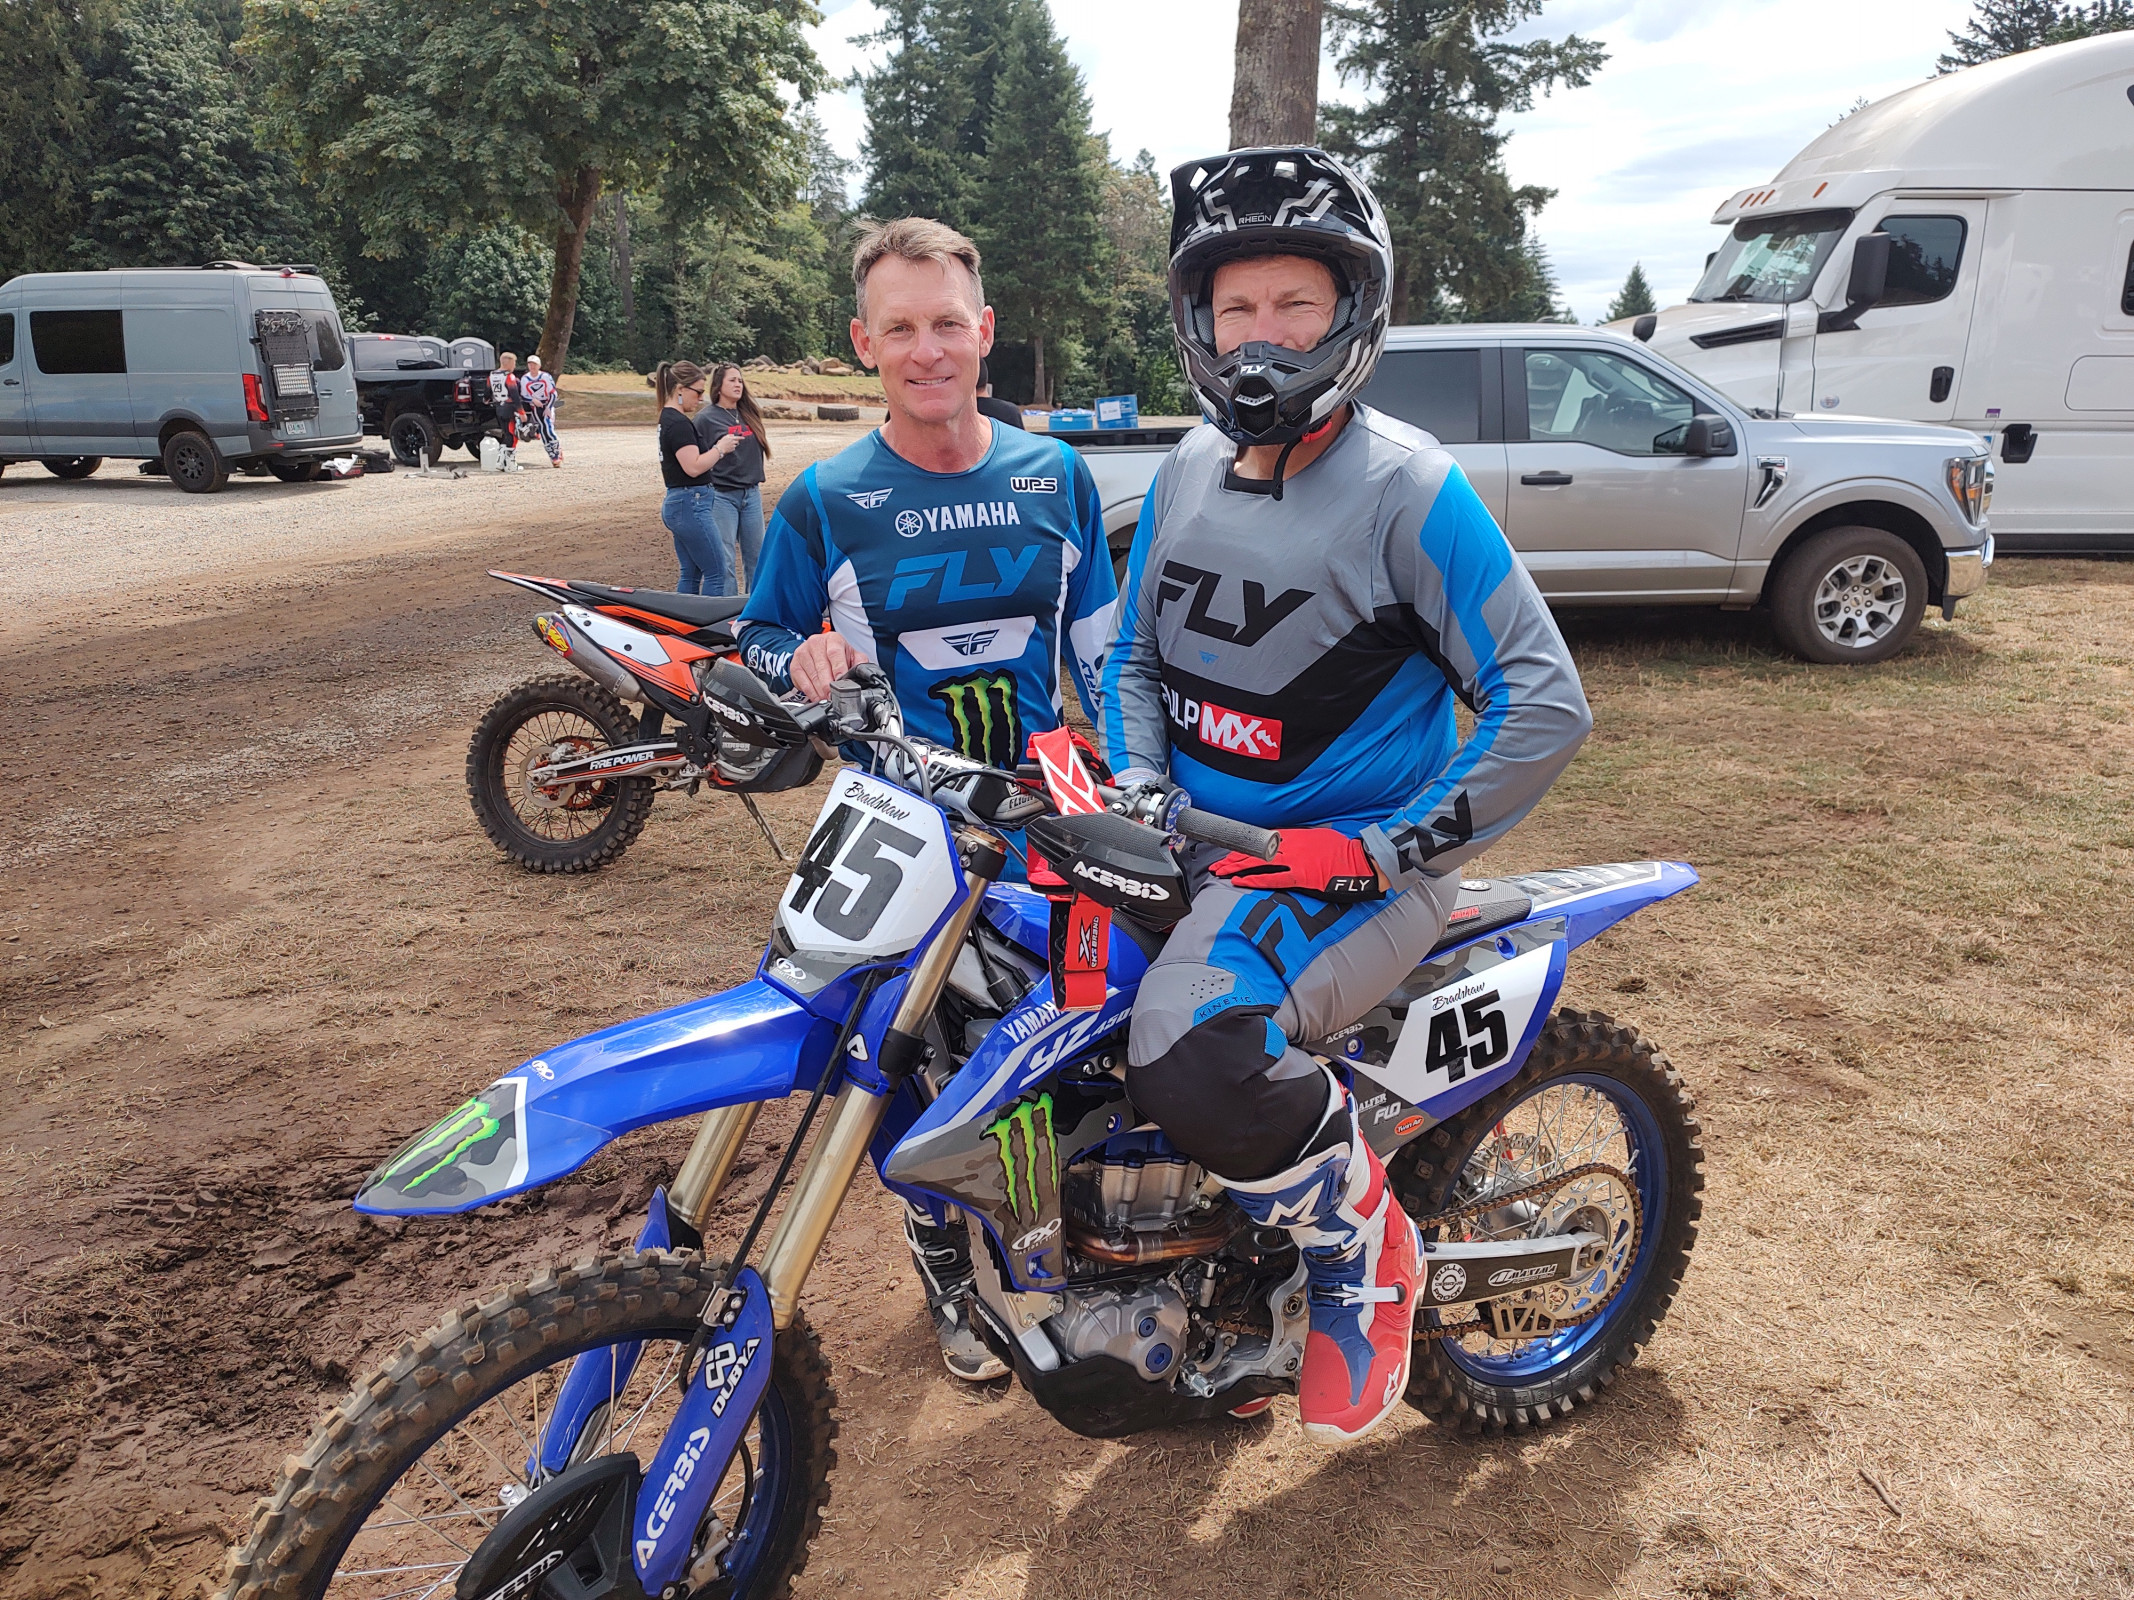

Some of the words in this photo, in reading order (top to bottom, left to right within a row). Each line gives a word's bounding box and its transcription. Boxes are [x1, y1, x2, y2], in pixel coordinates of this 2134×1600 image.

[1238, 214, 1272, 225] RHEON
[1240, 365, 1267, 375] FLY
[1012, 478, 1057, 492] WPS
[923, 501, 1021, 532] YAMAHA
[884, 544, 1042, 611] FLY
[1156, 560, 1317, 648] FLY
[612, 751, 655, 766] POWER
[844, 781, 911, 821] Bradshaw
[789, 802, 927, 941] 45
[1073, 861, 1170, 901] ACERBIS
[1334, 878, 1371, 892] FLY
[1199, 996, 1252, 1019] KINETIC
[1432, 982, 1486, 1010] Bradshaw
[1001, 1000, 1064, 1044] YAMAH
[1326, 1023, 1365, 1045] ACERBIS
[1425, 989, 1509, 1083] 45
[1434, 1264, 1466, 1281] BULLET
[1433, 1285, 1463, 1301] PROOF
[711, 1338, 761, 1418] DUBYA
[636, 1426, 710, 1569] ACERBIS
